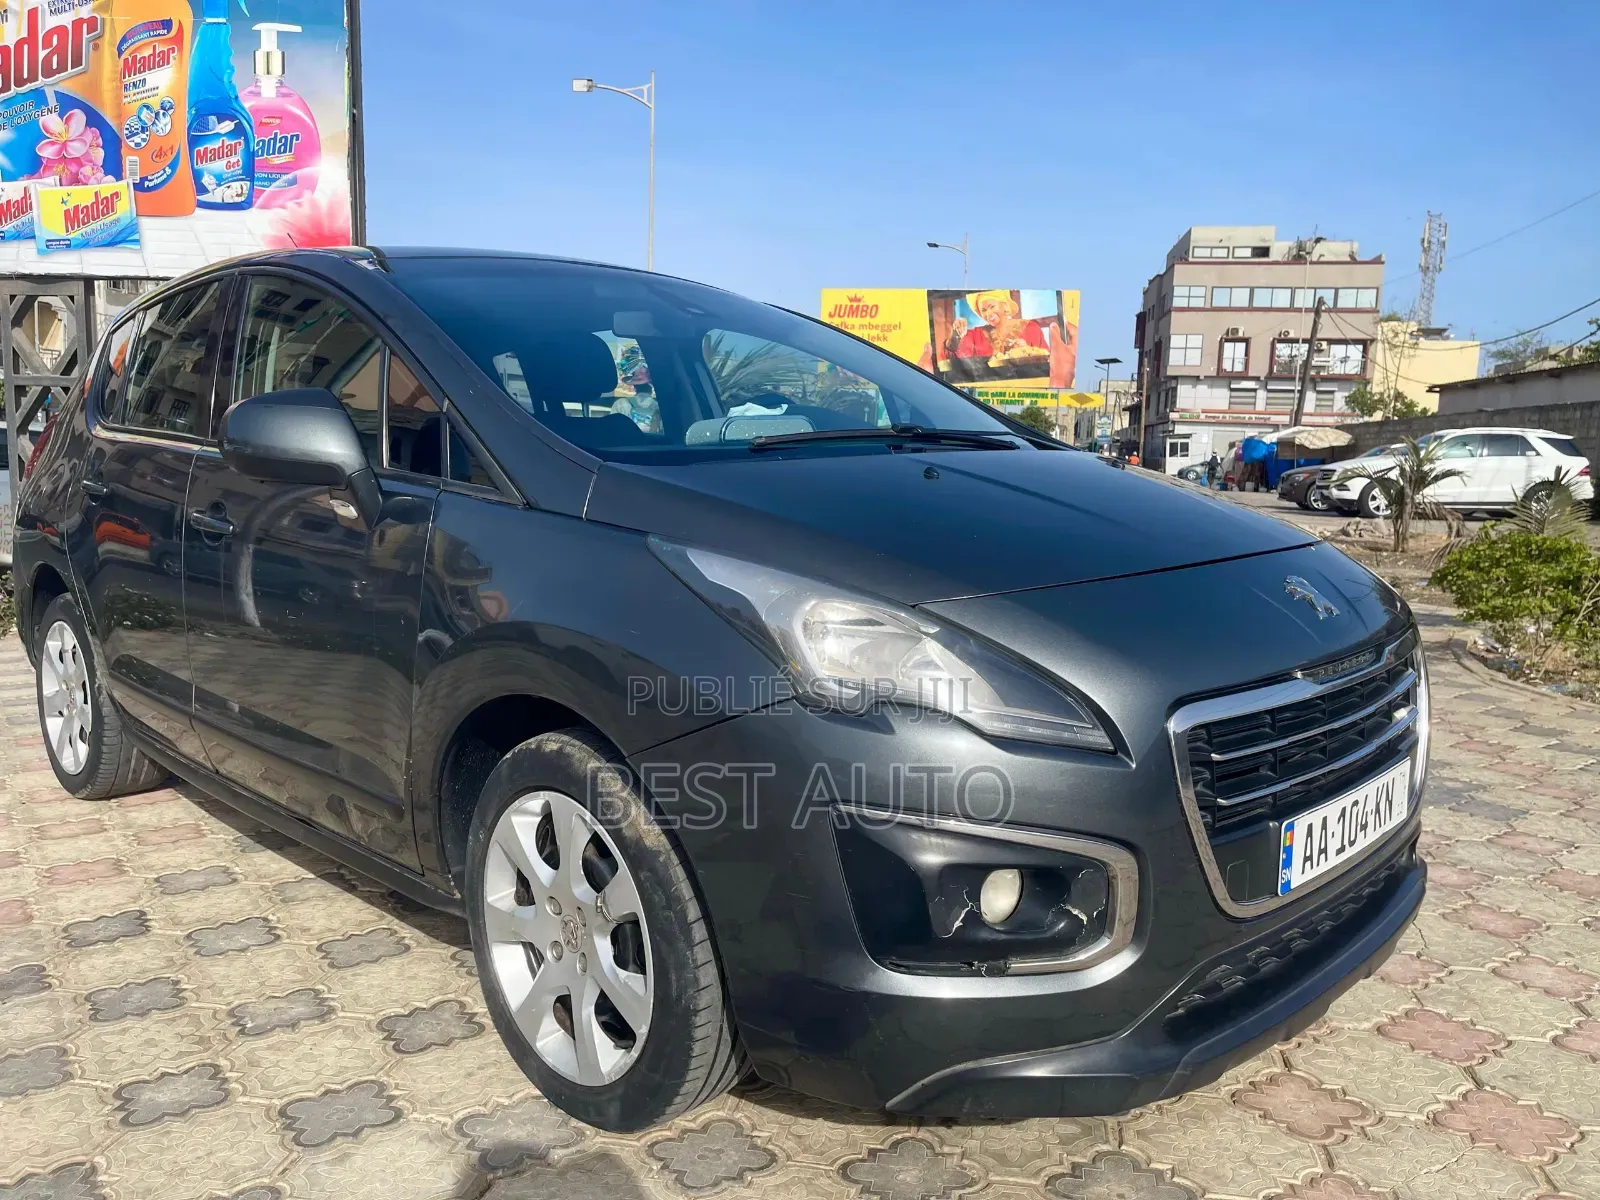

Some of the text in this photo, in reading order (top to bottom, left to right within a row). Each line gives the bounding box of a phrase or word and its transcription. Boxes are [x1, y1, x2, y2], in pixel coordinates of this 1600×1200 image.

[122, 44, 176, 80] Madar
[123, 78, 147, 93] RENZO
[10, 103, 60, 128] L'OXYGÈNE
[195, 138, 242, 167] Madar
[225, 158, 241, 171] Get
[63, 190, 120, 234] Madar
[828, 304, 879, 318] JUMBO
[858, 321, 902, 333] mbeggel
[1281, 867, 1293, 883] SN
